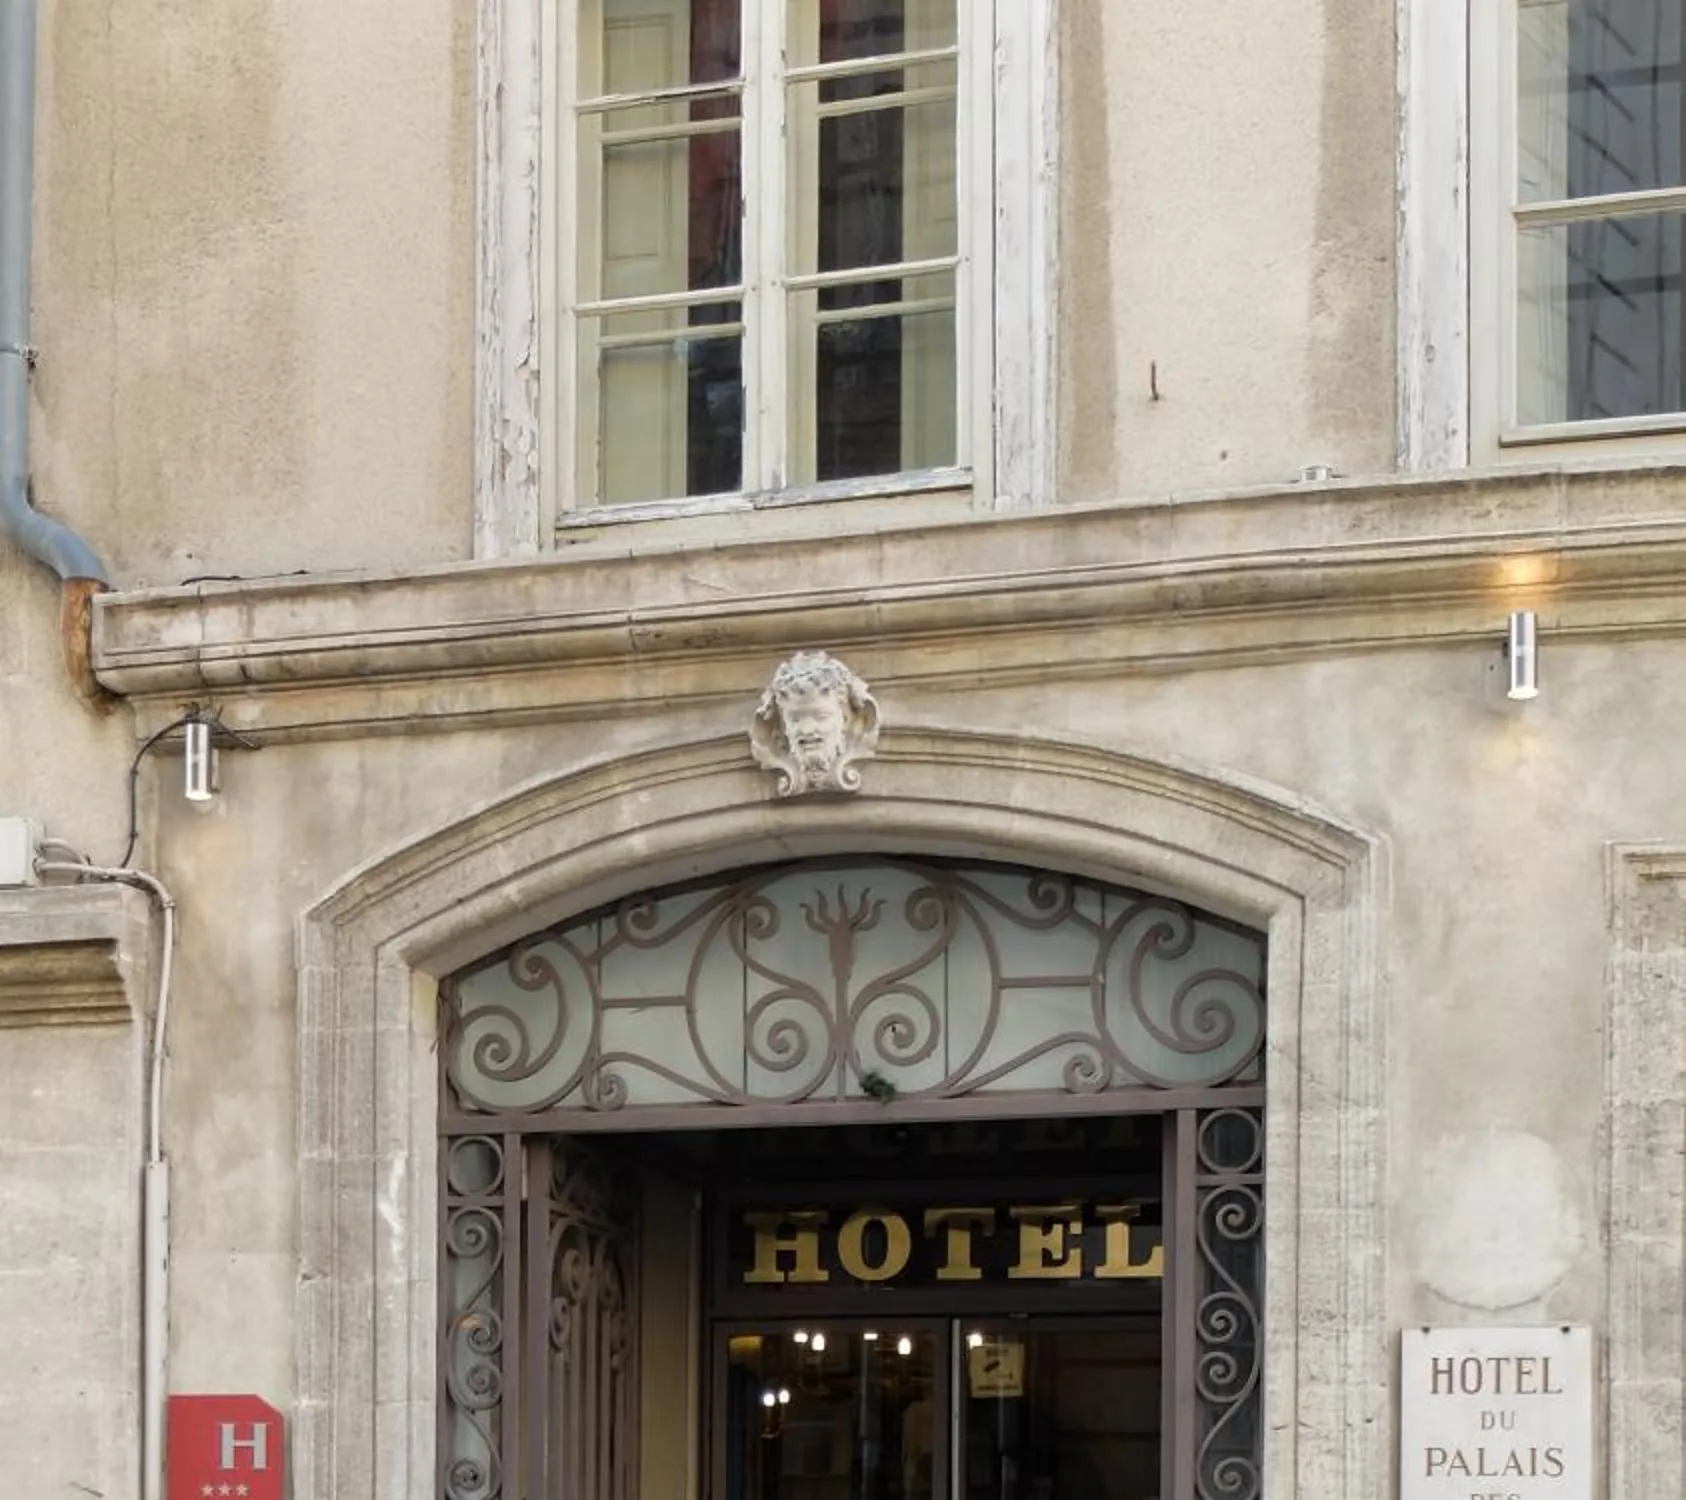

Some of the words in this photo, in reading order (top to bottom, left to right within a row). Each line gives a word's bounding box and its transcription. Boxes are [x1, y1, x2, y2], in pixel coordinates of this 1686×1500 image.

[743, 1204, 1164, 1284] HOTEL
[1480, 1410, 1516, 1431] DU
[220, 1422, 268, 1470] H
[1424, 1447, 1565, 1478] PALAIS
